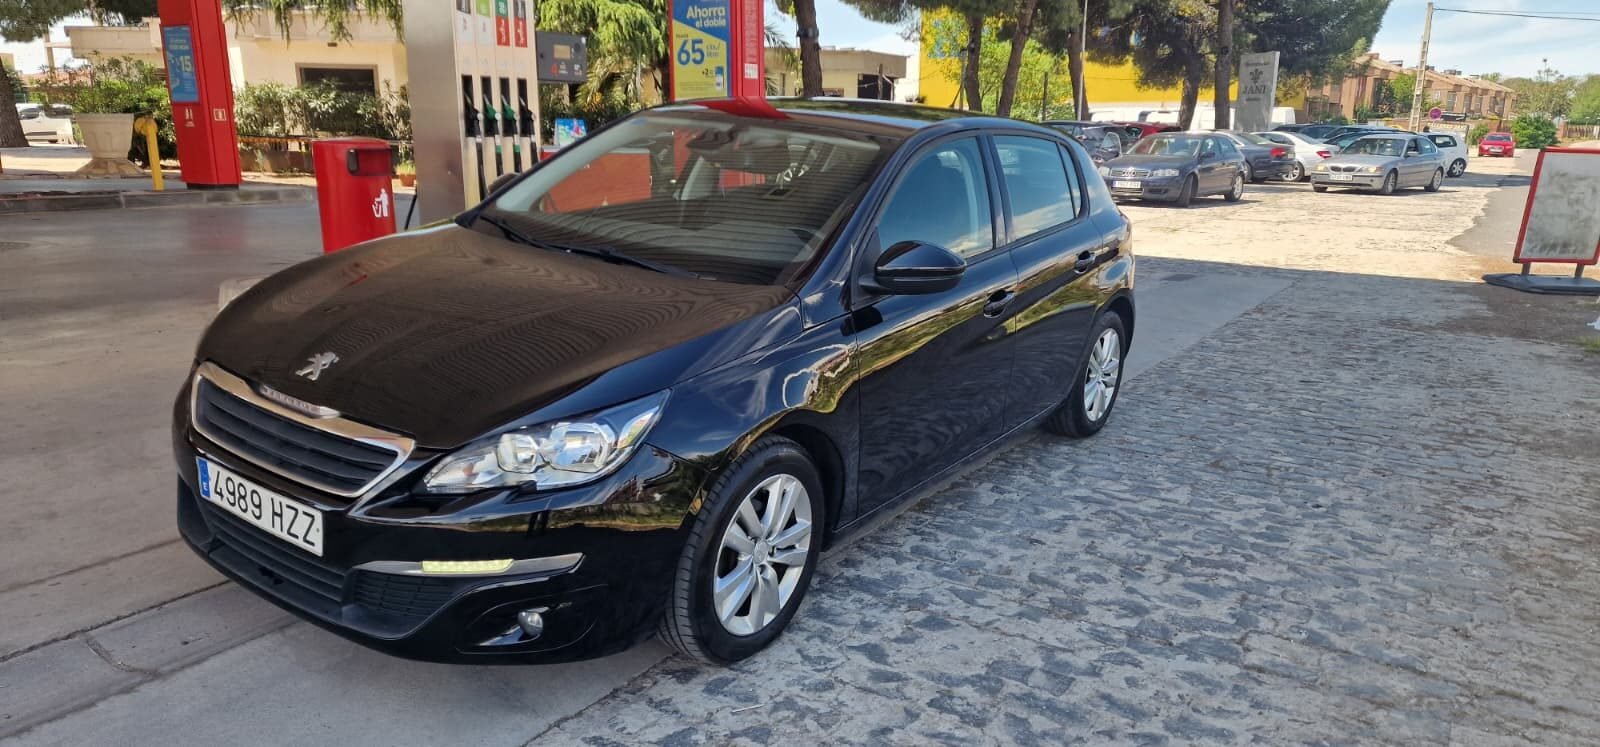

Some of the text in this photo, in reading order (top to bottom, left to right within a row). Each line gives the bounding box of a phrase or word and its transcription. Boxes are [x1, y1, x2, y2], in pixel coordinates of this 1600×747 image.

[687, 6, 725, 19] Ahorra
[695, 17, 726, 28] el doble
[678, 38, 705, 65] 65
[214, 470, 316, 548] 4989 HZZ
